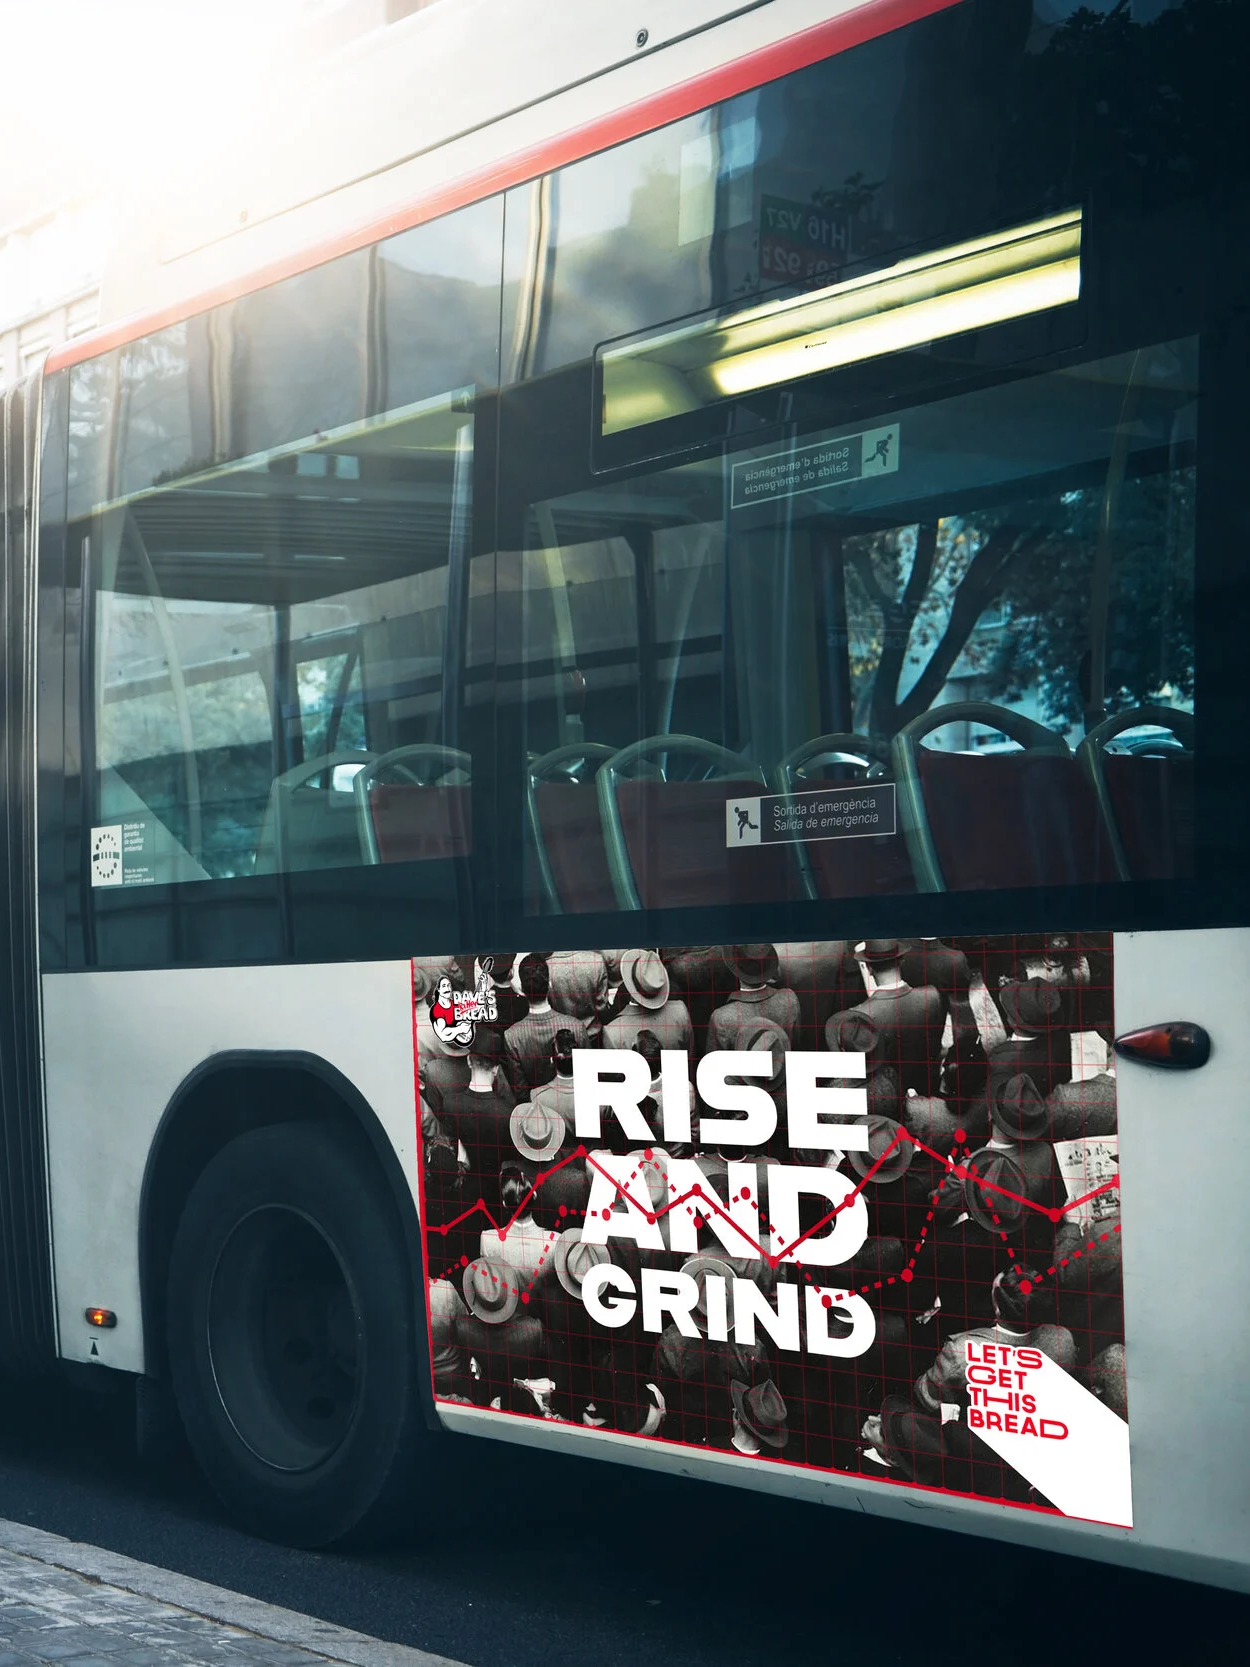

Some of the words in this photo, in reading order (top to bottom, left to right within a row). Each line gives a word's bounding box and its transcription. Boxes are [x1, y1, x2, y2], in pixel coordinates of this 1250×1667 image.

[773, 803, 807, 817] Sortida
[773, 818, 803, 832] Salida
[806, 817, 818, 829] de
[821, 812, 879, 827] emergencia
[453, 990, 496, 1005] DAVE'S
[454, 1006, 498, 1021] BREAD
[572, 1048, 869, 1151] RISE
[580, 1154, 869, 1267] AND
[581, 1263, 876, 1358] GRIND
[968, 1343, 1043, 1369] LET'S
[968, 1365, 1027, 1390] GET
[969, 1387, 1037, 1413] THIS
[970, 1408, 1069, 1440] BREAD
